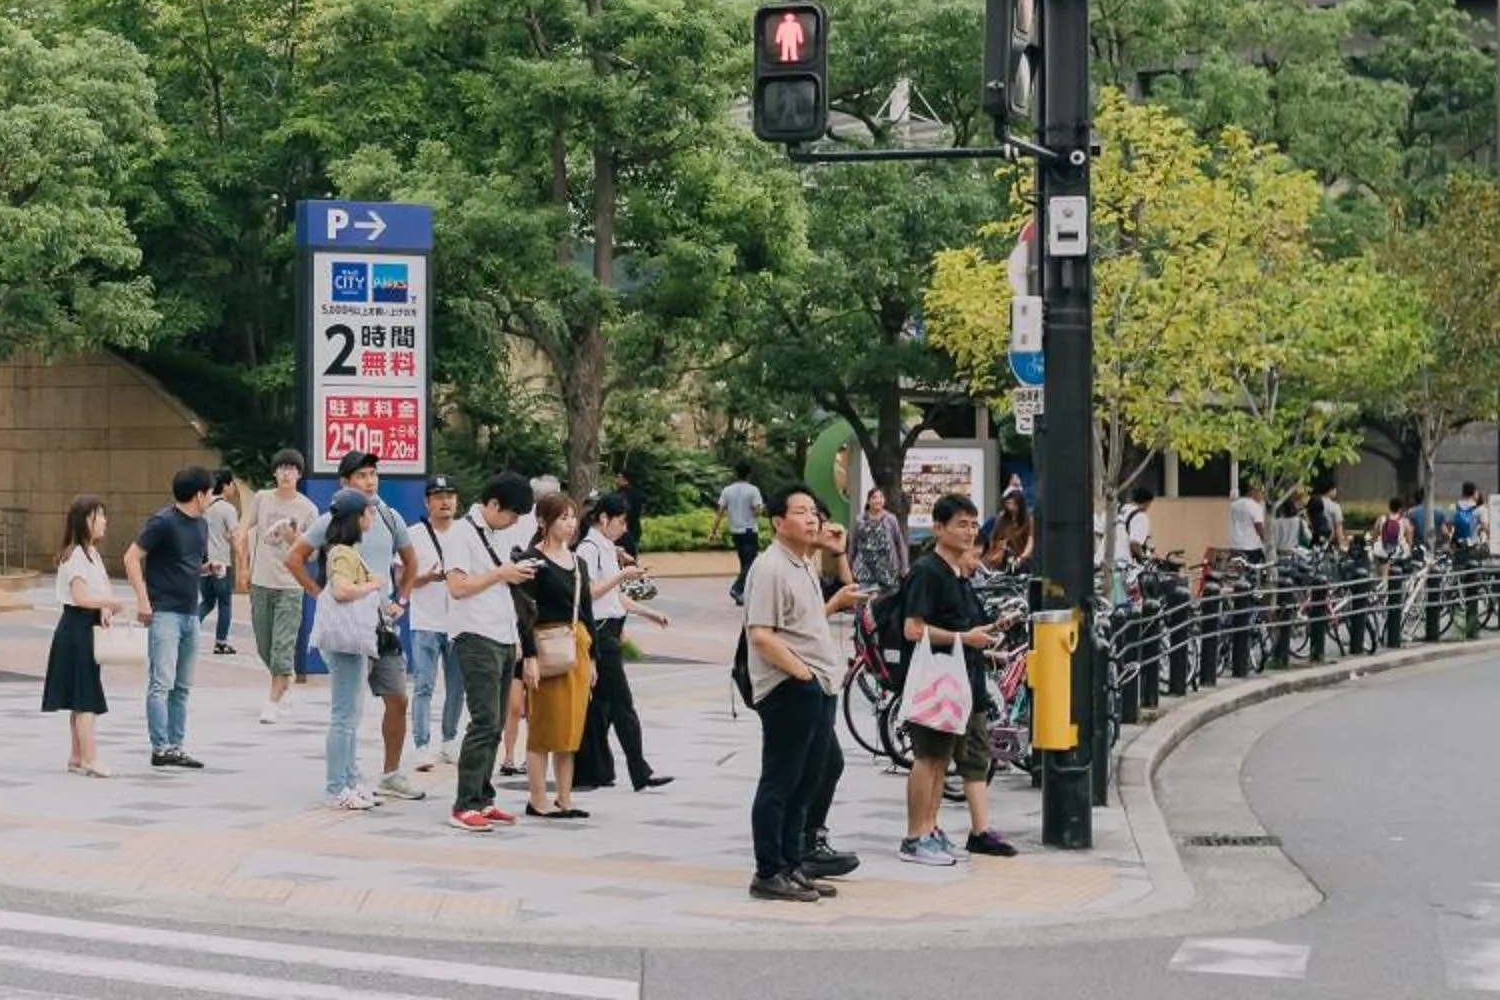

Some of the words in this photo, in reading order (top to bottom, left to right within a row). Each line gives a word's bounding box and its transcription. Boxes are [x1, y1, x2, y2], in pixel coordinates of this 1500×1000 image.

[327, 209, 349, 239] P
[334, 275, 365, 290] CITY
[361, 325, 415, 349] 時間
[361, 350, 416, 377] 無料
[329, 399, 416, 419] 駐車料金
